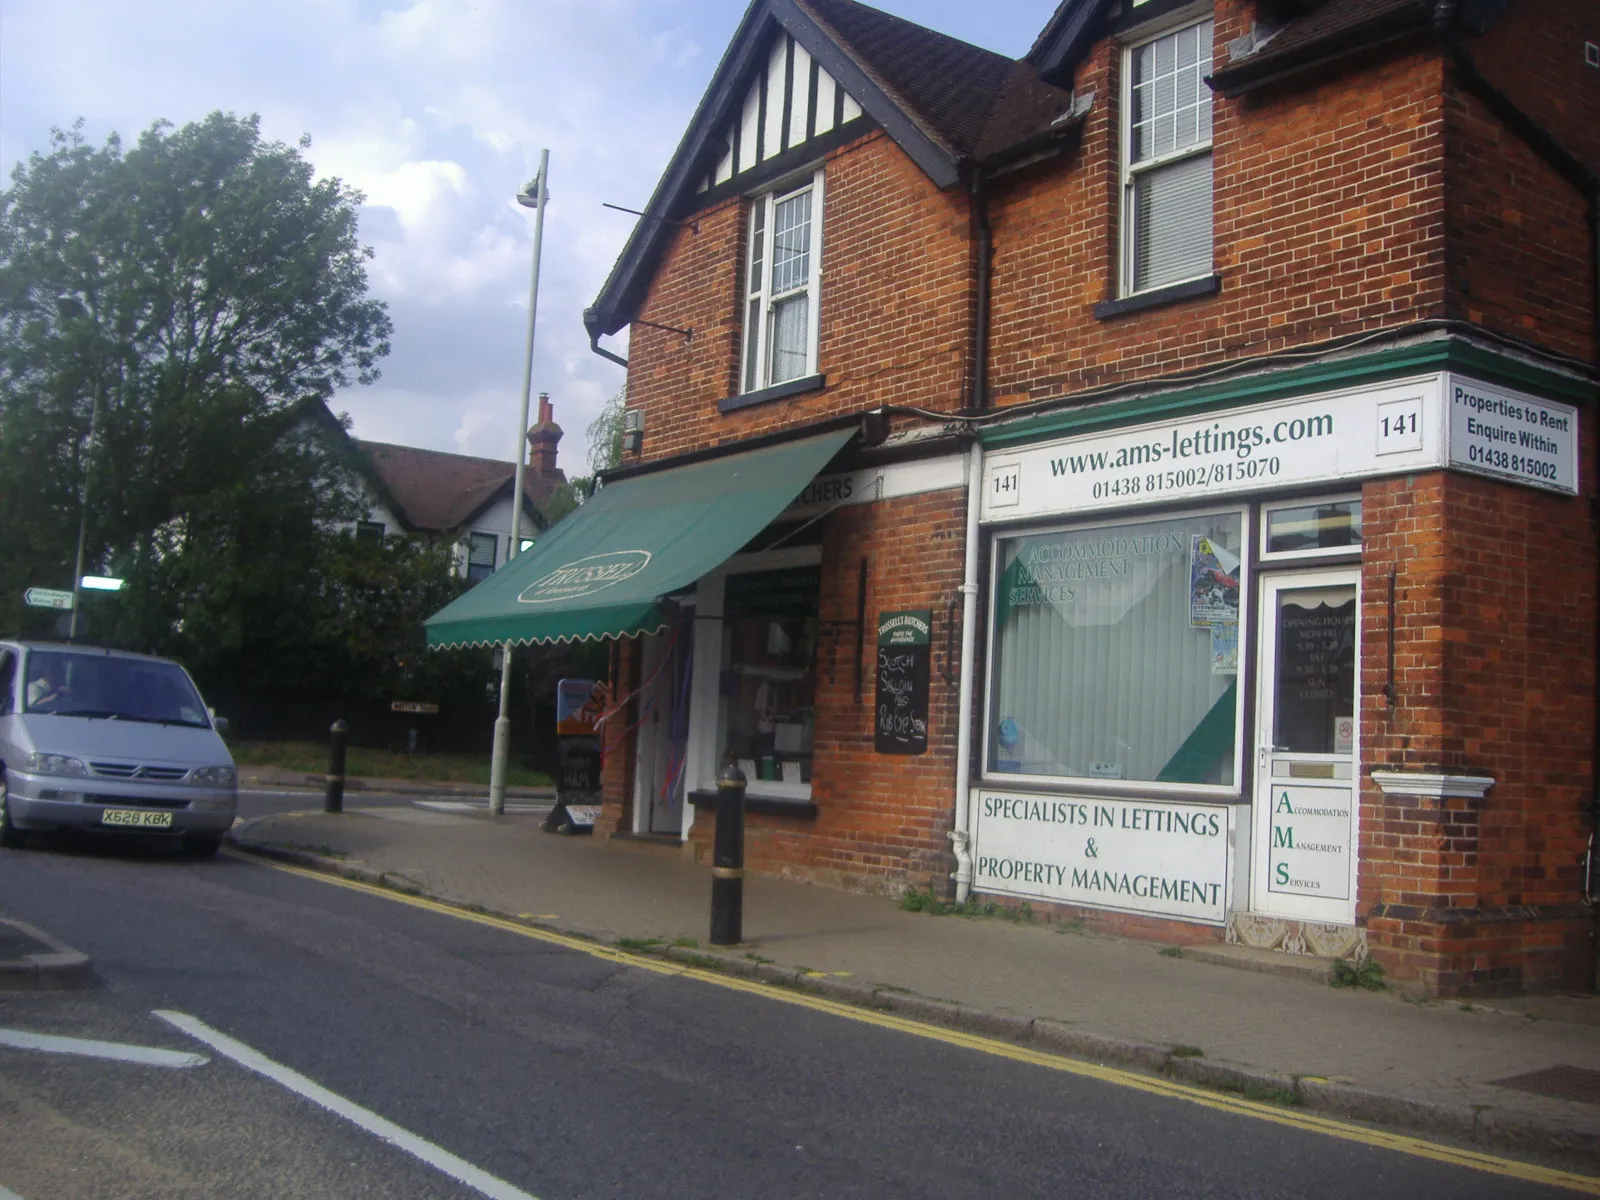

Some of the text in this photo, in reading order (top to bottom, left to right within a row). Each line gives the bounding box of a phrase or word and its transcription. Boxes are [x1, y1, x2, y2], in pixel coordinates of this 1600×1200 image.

[1455, 387, 1568, 432] Properties to Rent
[1381, 412, 1417, 437] 141
[1467, 417, 1558, 455] Enquire Within
[1050, 413, 1333, 477] www.ams-lettings.com
[1469, 445, 1557, 480] 01438 815002
[794, 477, 853, 505] CHERS
[993, 474, 1017, 493] 141
[1092, 456, 1280, 499] 01438 815002/815070
[1027, 532, 1183, 565] ACCOMMODATION
[1018, 559, 1129, 585] MANAGEMENT
[1008, 585, 1075, 606] SERVICES
[984, 797, 1220, 836] SPECIALISTS IN LETTINGS
[1276, 791, 1349, 817] ACCOMMODATION
[1084, 837, 1099, 858] &
[1273, 826, 1343, 853] MANAGEMENT
[978, 857, 1222, 906] PROPERTY MANAGEMENT
[1276, 862, 1321, 889] SERVICES
